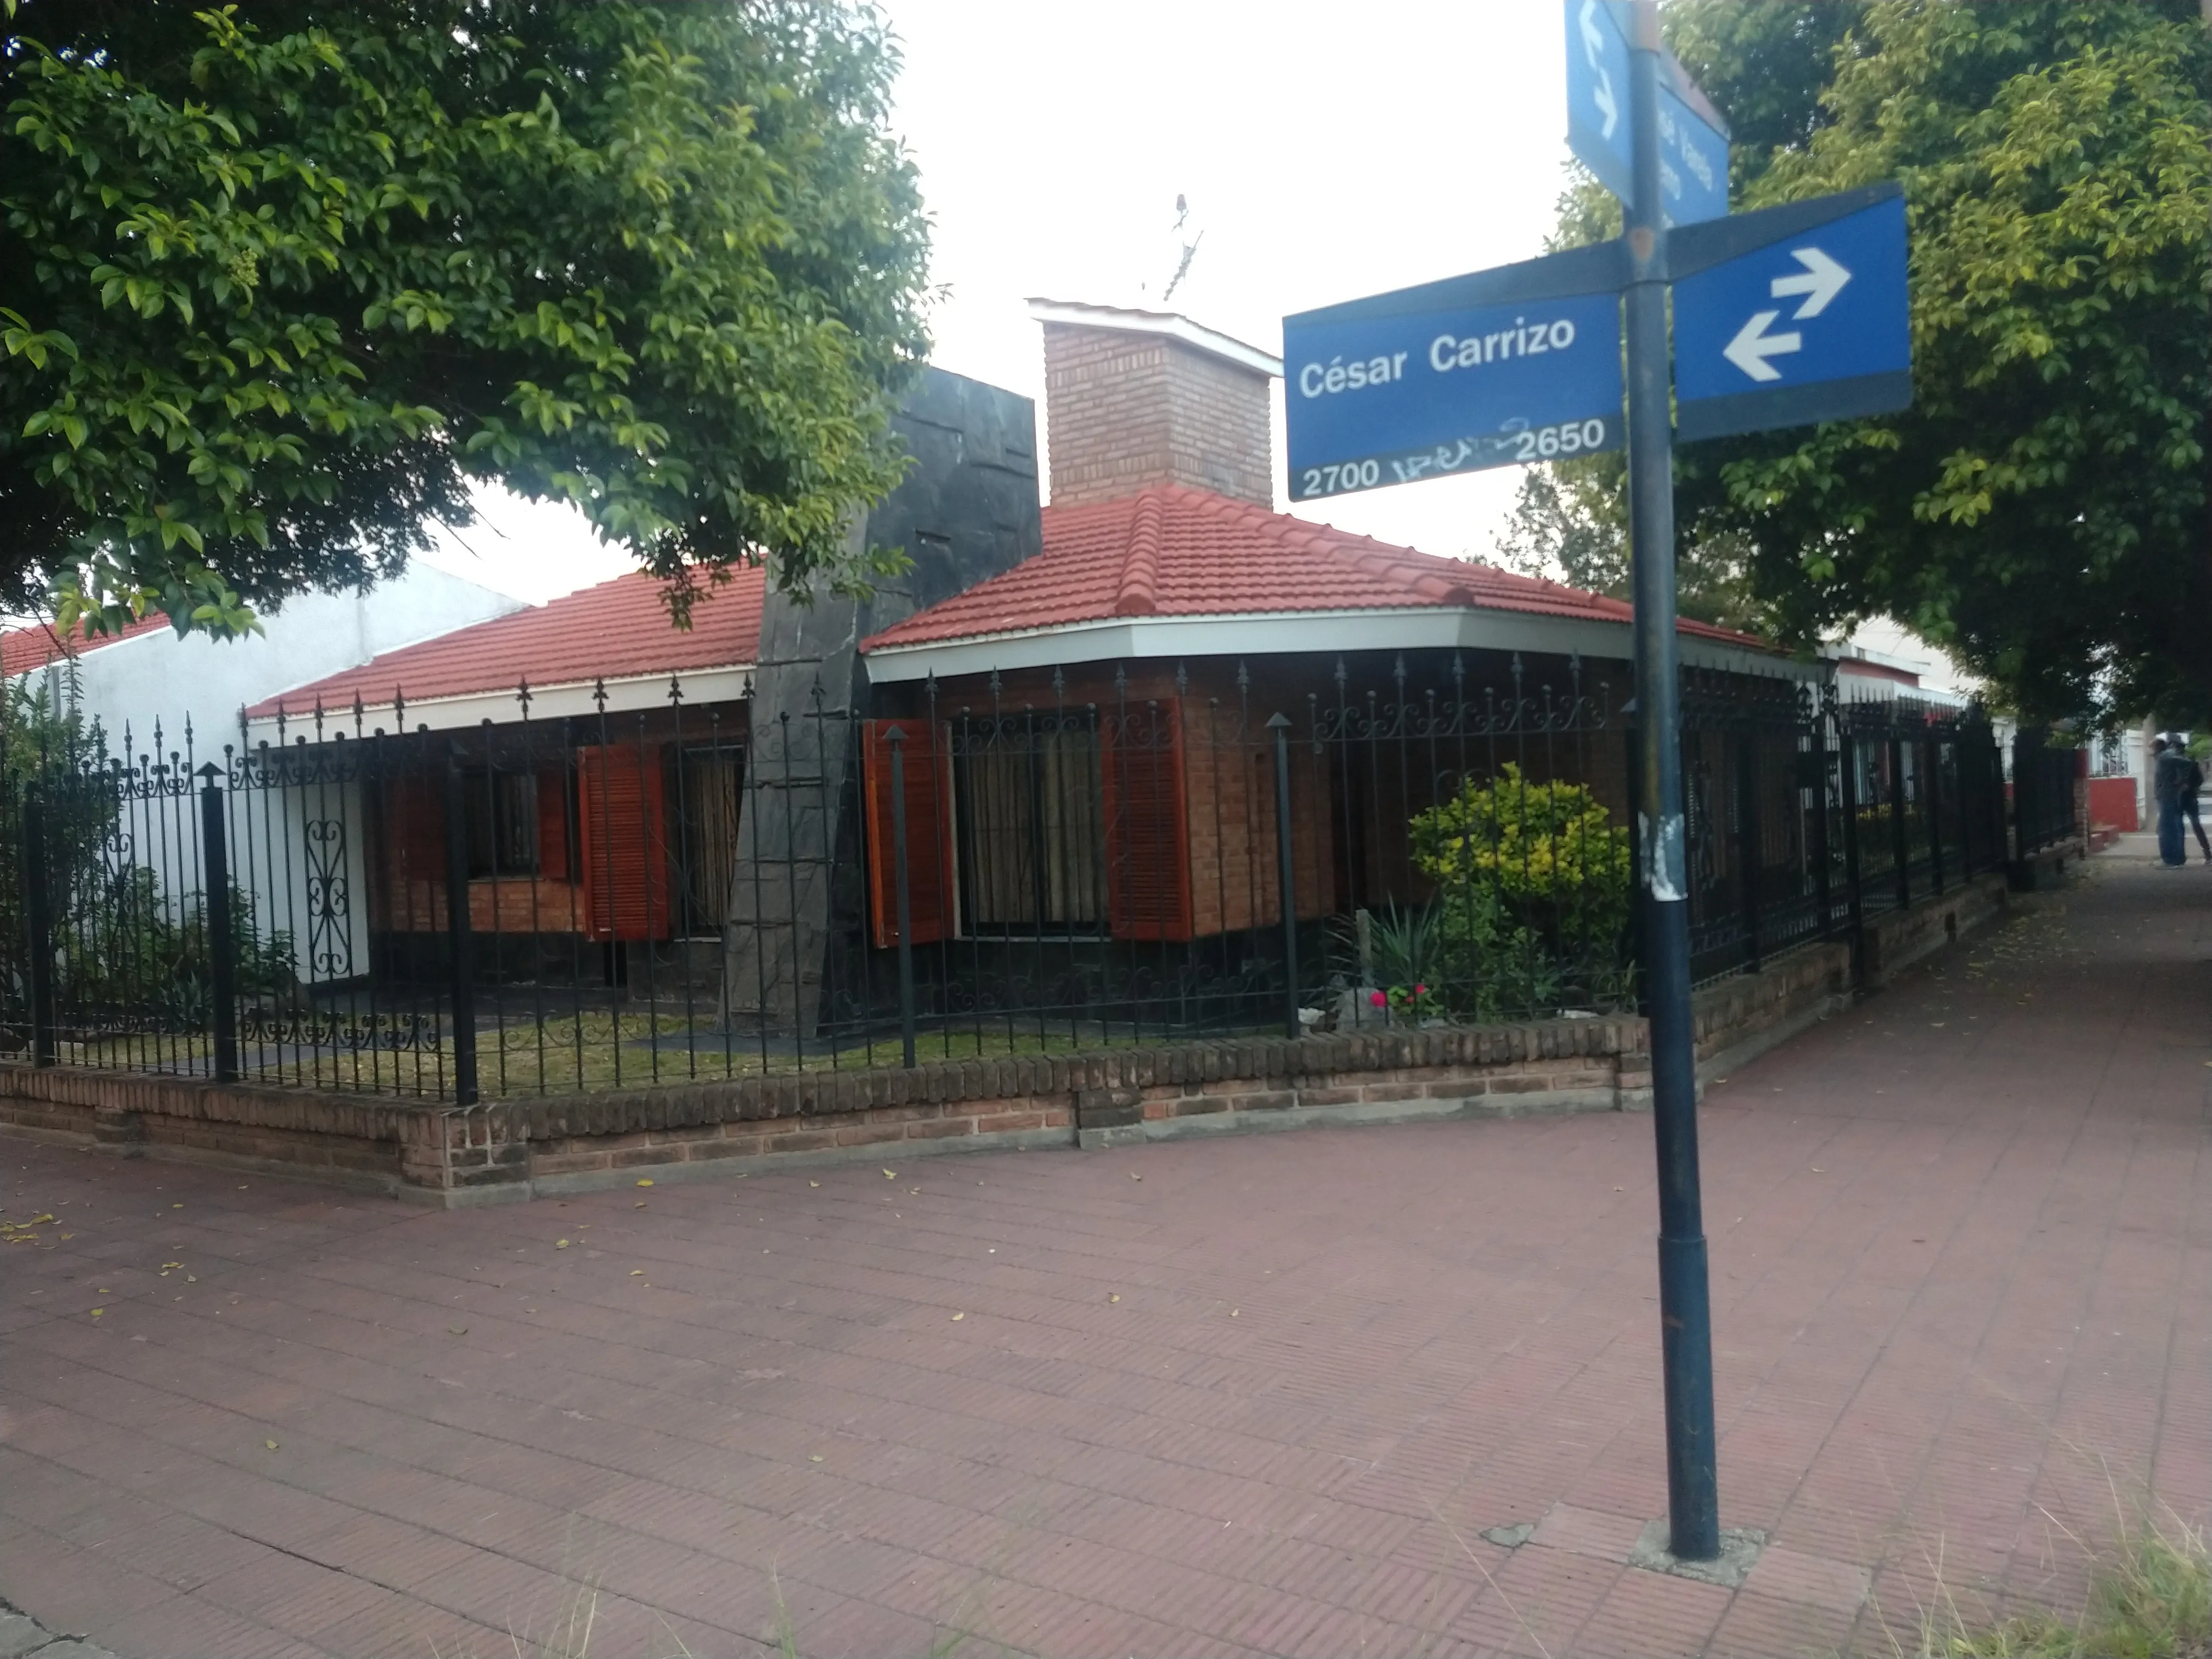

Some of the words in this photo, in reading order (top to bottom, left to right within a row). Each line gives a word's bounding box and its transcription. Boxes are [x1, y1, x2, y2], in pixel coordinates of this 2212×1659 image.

[1300, 354, 1407, 398] César
[1430, 317, 1575, 372] Carrizo
[1304, 460, 1379, 496] 2700
[1516, 419, 1605, 461] 2650
